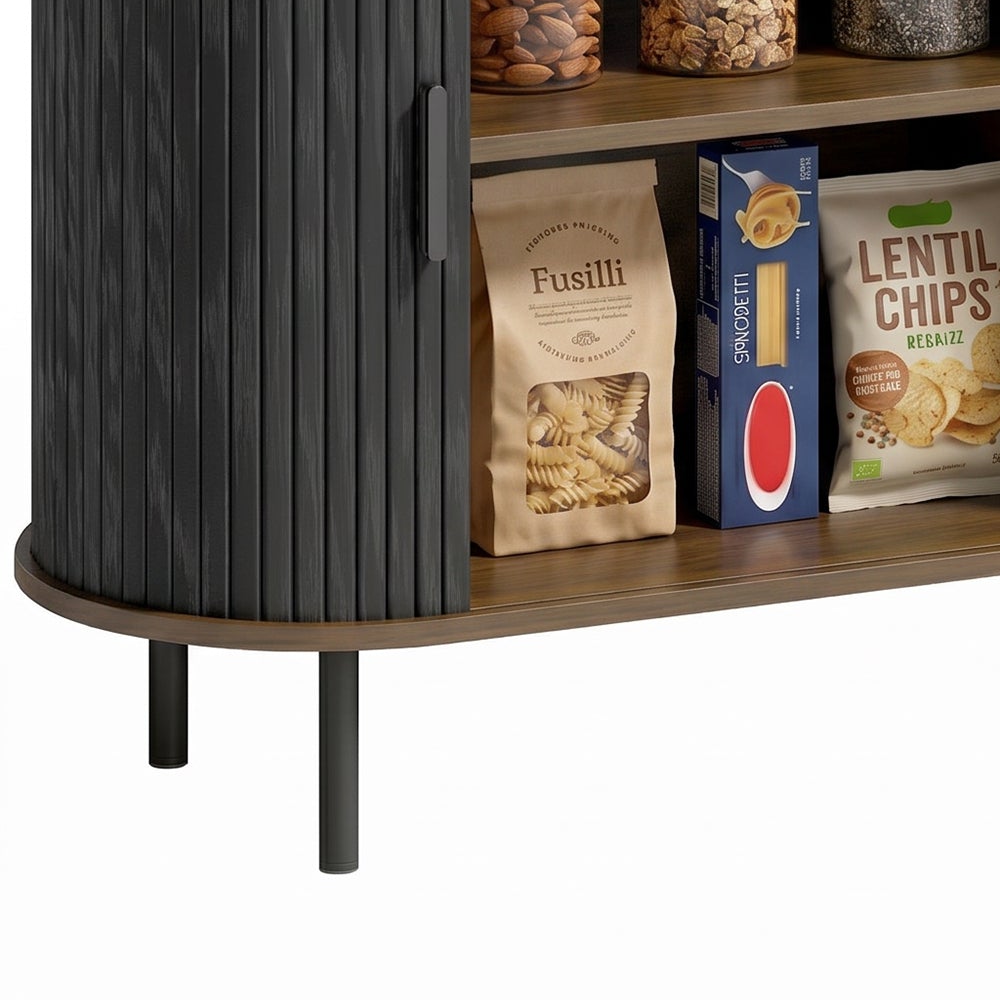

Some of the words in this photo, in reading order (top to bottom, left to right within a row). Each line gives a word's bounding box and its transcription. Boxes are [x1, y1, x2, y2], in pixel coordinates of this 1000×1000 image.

[530, 258, 627, 295] Fusilli
[858, 228, 998, 284] LENTIL
[874, 277, 992, 331] CHIPS
